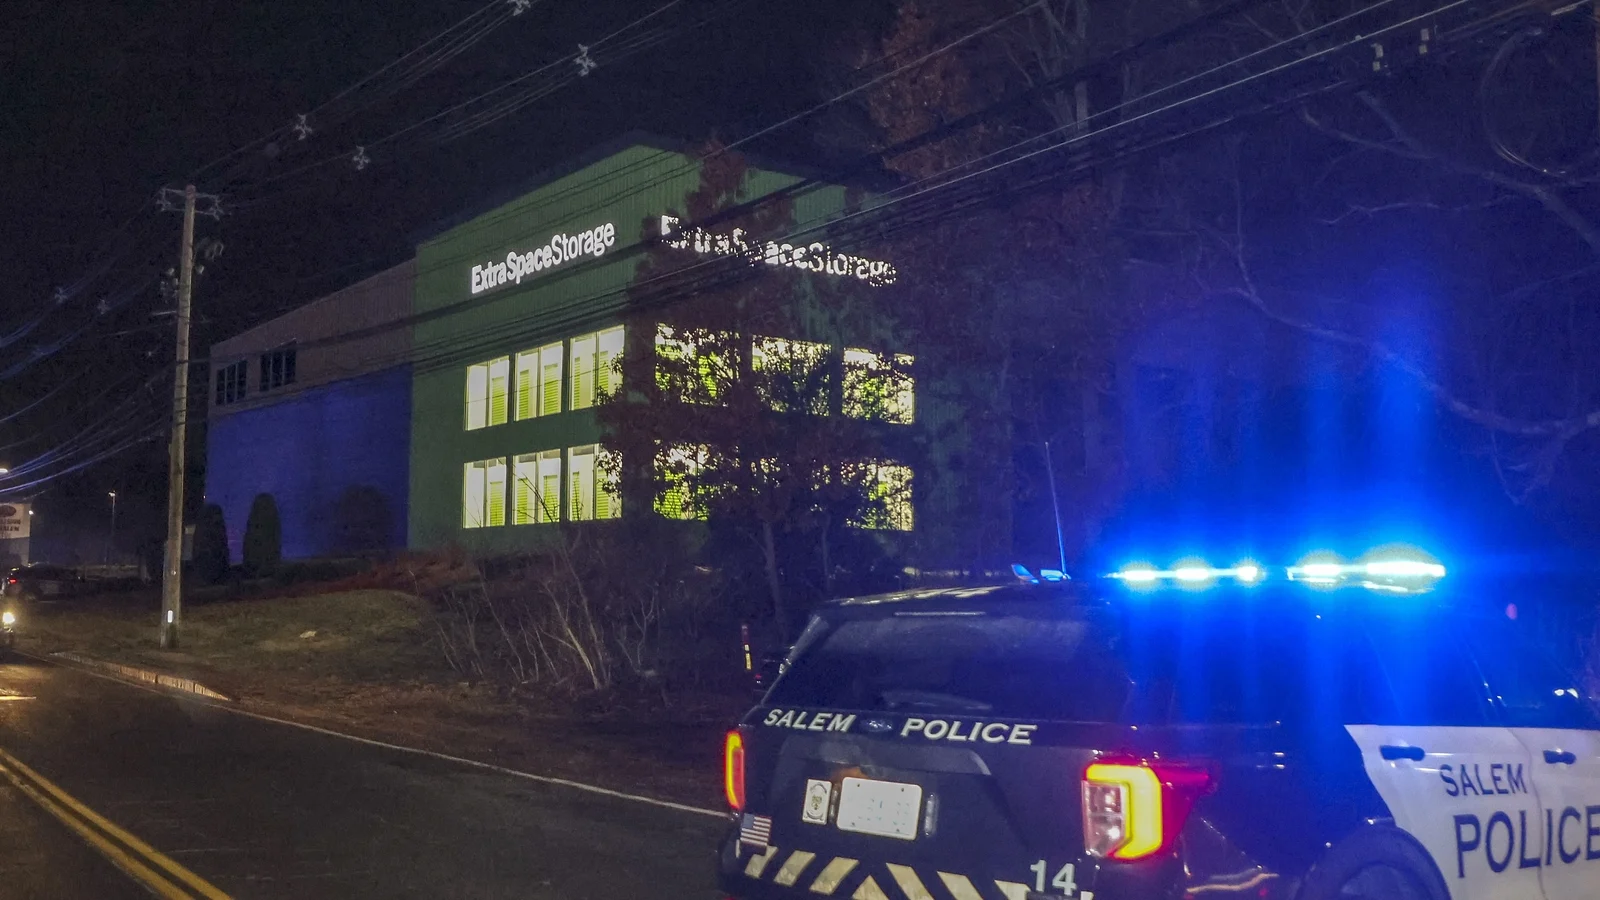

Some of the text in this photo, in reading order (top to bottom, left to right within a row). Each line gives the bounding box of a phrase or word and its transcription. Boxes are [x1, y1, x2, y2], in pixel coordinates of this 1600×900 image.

[763, 708, 1038, 745] SALEM POLICE
[1439, 763, 1528, 797] SALEM
[1453, 805, 1600, 878] POLICE
[1030, 859, 1077, 896] 14
